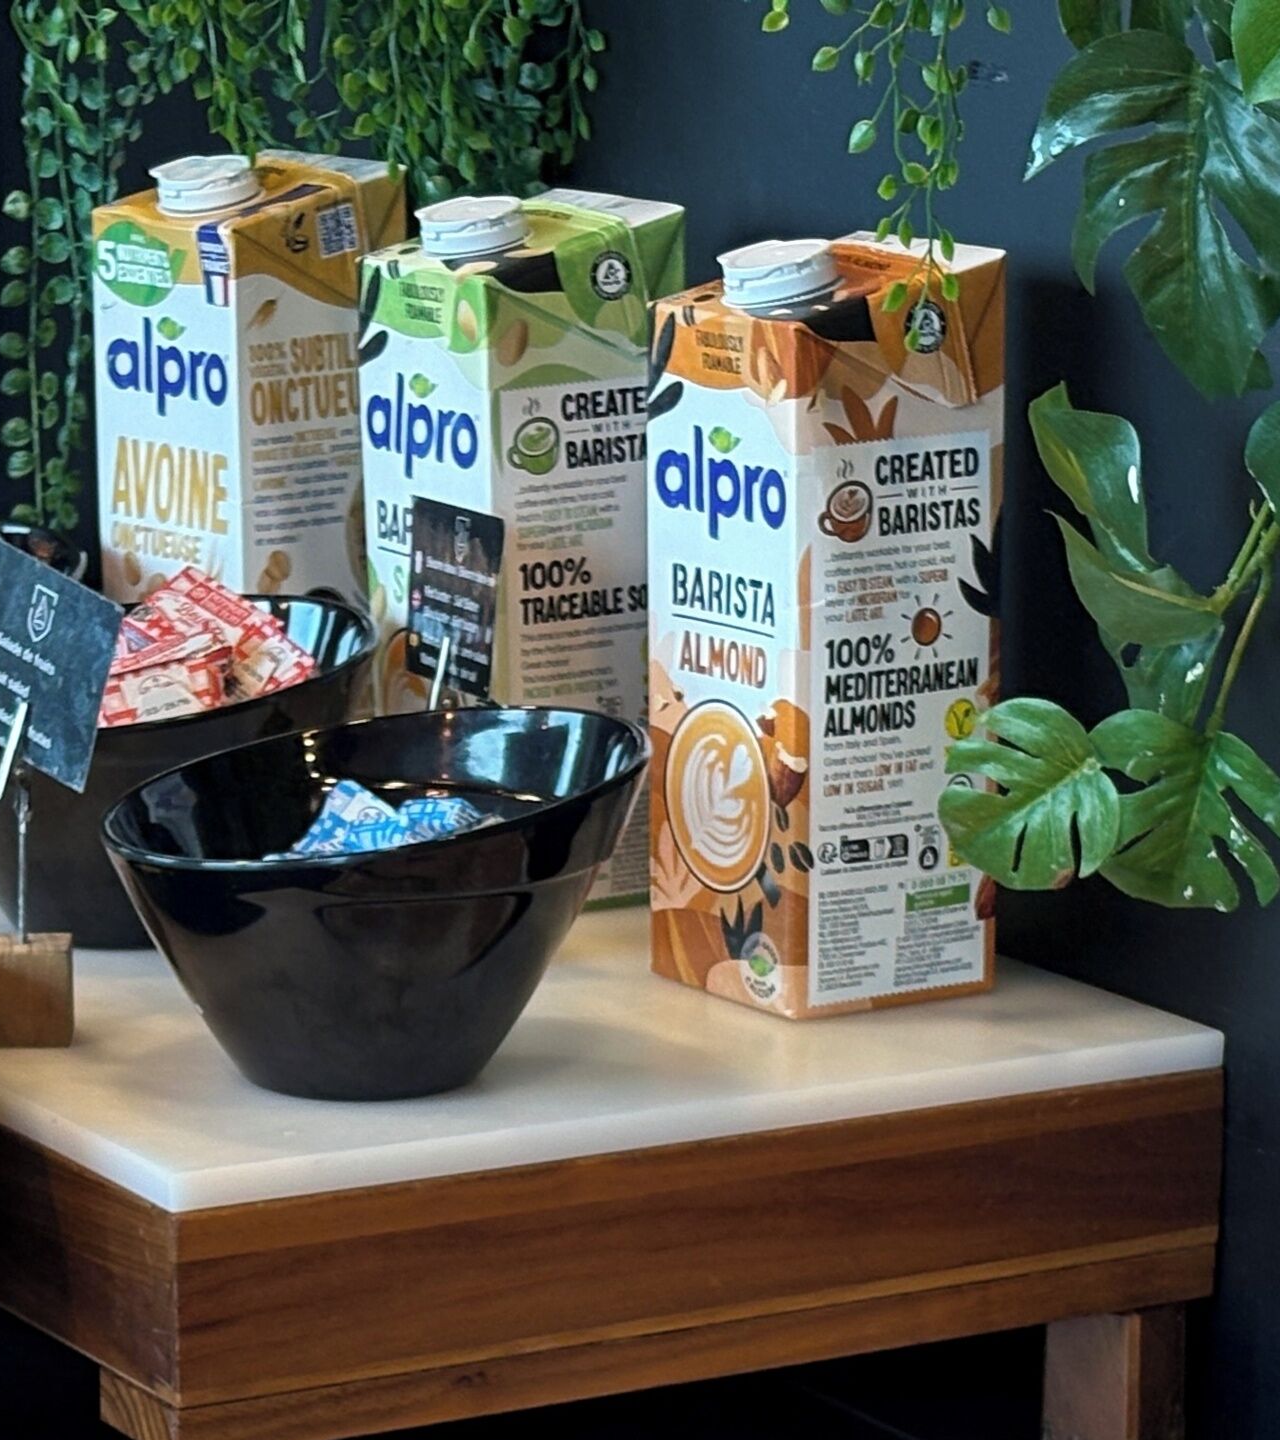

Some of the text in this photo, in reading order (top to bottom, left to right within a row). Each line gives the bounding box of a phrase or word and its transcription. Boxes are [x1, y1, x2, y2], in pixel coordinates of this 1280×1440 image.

[97, 240, 116, 280] 5
[107, 317, 227, 416] alpro
[291, 332, 359, 373] SUBTIL
[561, 386, 647, 421] CREATE
[366, 372, 478, 479] alpro
[565, 434, 647, 469] BARISTA
[875, 447, 980, 486] CREATED
[111, 436, 229, 535] AVOINE
[655, 425, 787, 540] alpro
[906, 485, 948, 499] WITH
[878, 498, 981, 537] BARISTAS
[519, 556, 592, 591] 100%
[520, 587, 624, 625] TRACEABLE
[628, 583, 648, 612] SO
[671, 562, 776, 628] BARISTA
[679, 629, 768, 690] ALMOND
[825, 633, 895, 670] 100%
[824, 657, 979, 705] MEDITERRANEAN
[824, 700, 916, 738] ALMONDS
